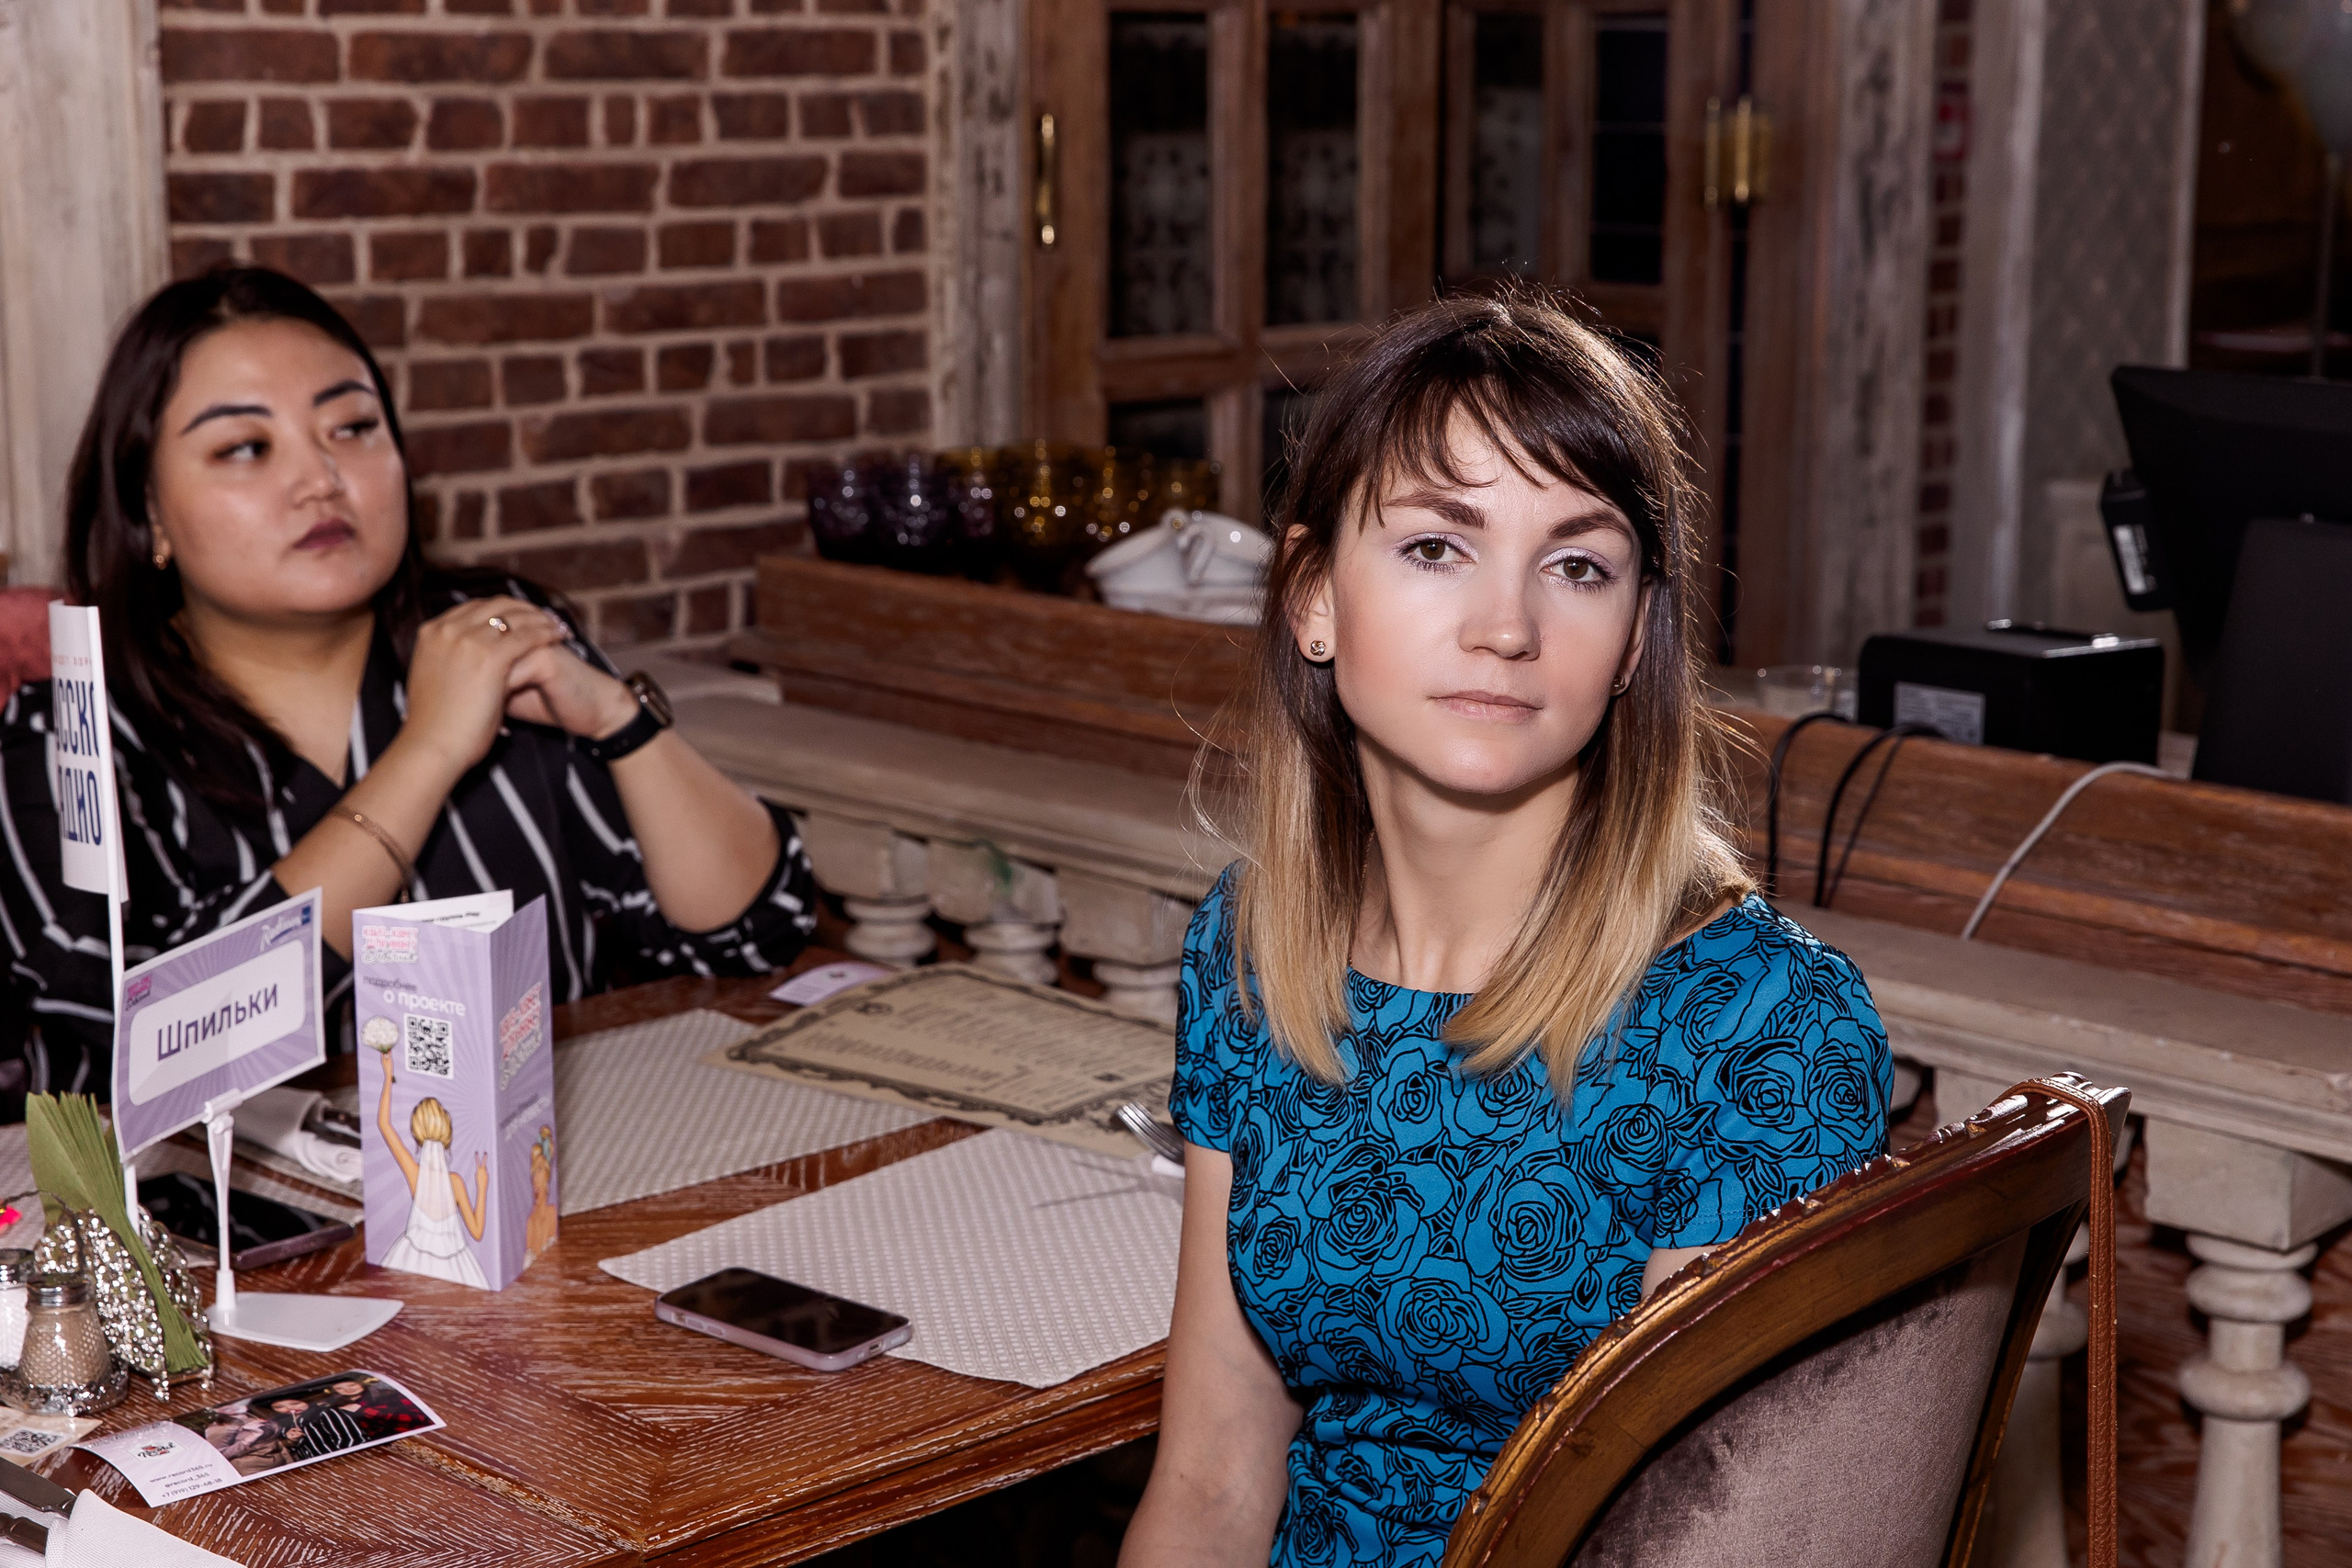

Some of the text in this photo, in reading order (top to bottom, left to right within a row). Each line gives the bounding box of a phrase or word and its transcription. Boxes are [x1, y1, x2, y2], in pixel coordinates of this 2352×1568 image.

[157, 984, 278, 1062] Шпильки
[383, 989, 467, 1017] о проекте
